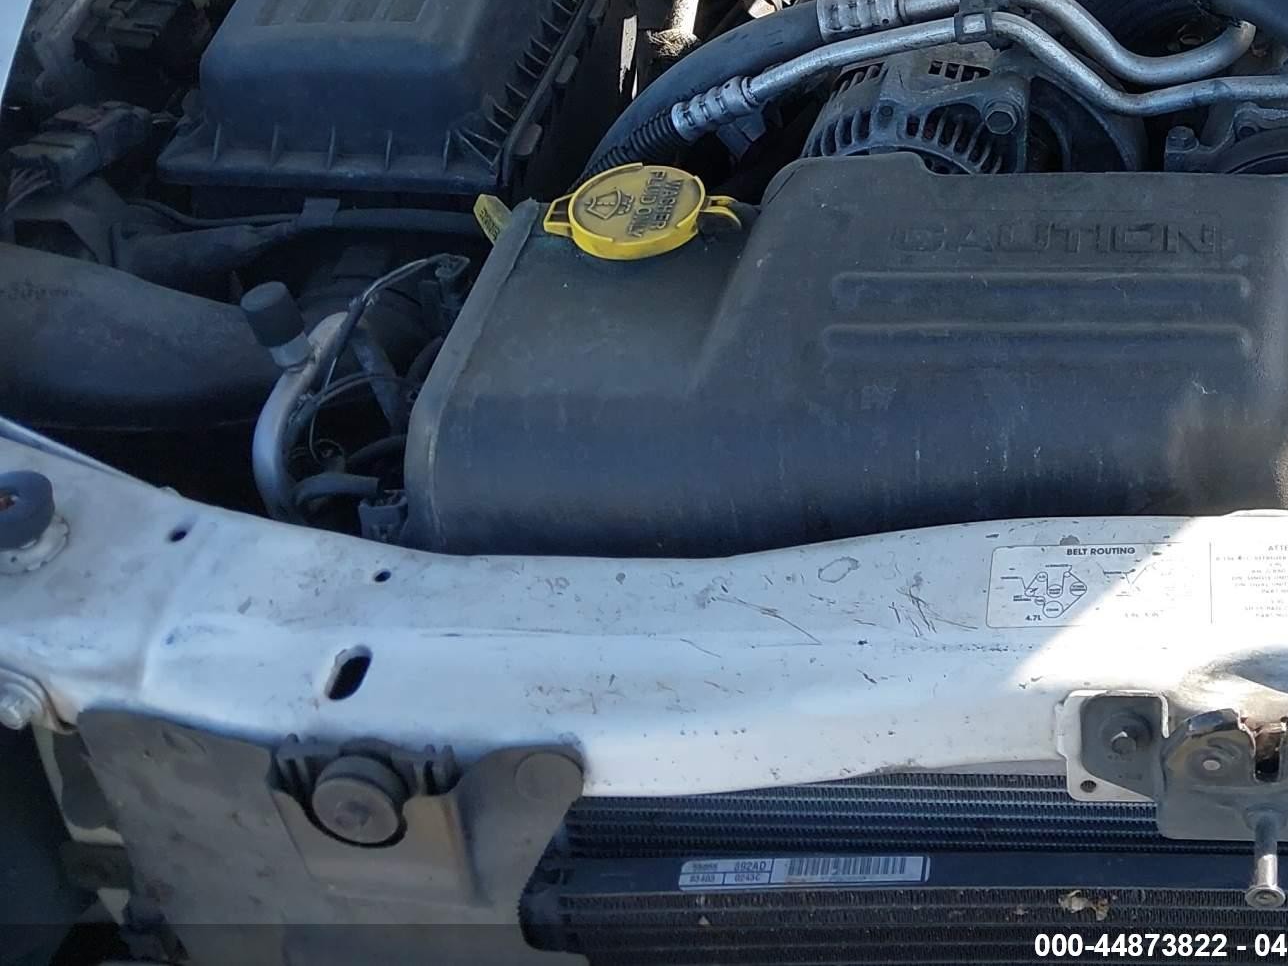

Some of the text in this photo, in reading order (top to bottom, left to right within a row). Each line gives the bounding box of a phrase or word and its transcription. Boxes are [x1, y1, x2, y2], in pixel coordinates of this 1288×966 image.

[628, 171, 667, 237] FLUID ONLY
[649, 178, 683, 230] WASHER
[892, 222, 1217, 254] CAUTION
[1067, 547, 1136, 556] BELT ROUTING
